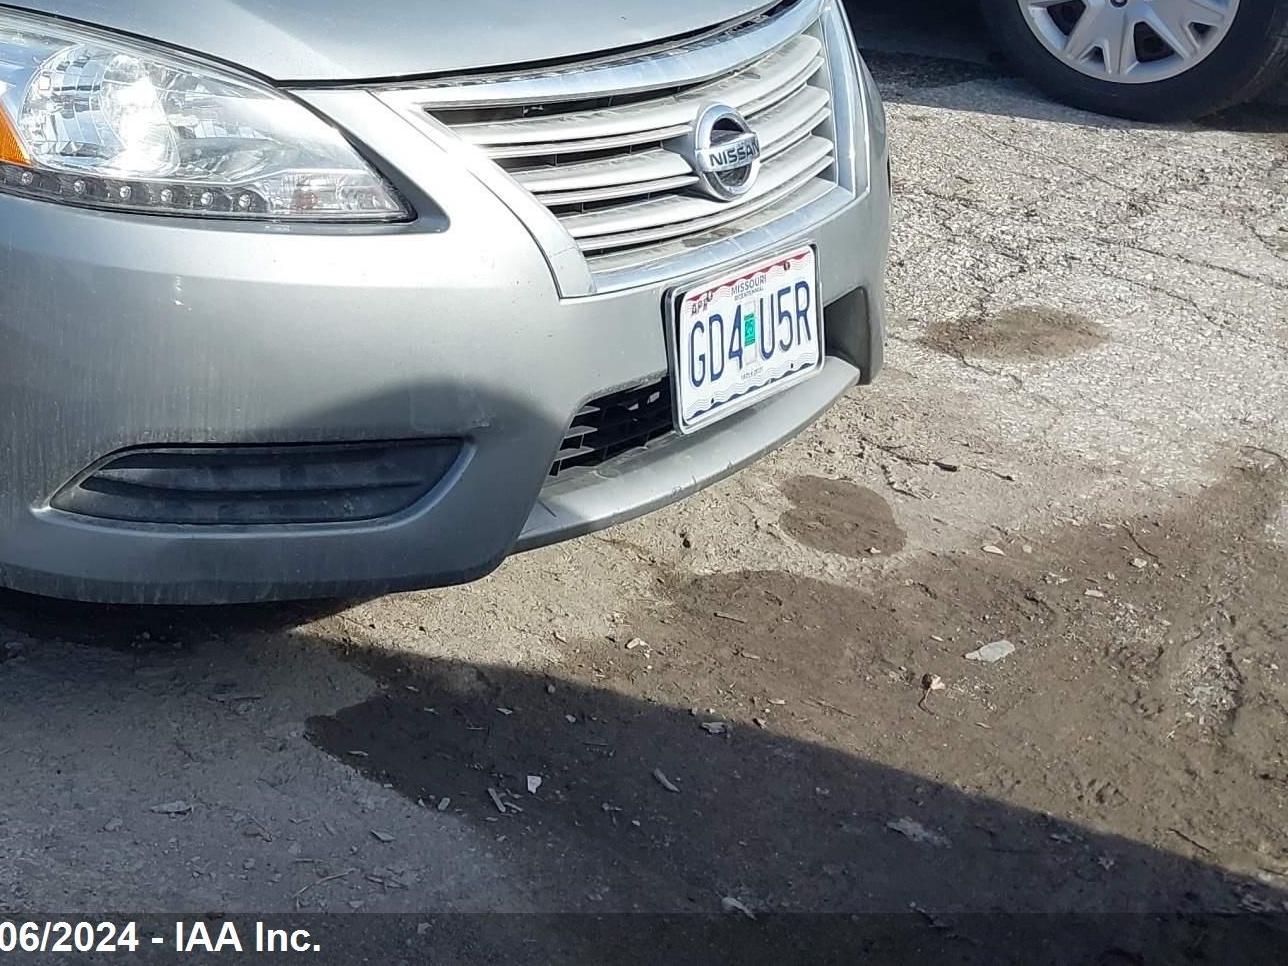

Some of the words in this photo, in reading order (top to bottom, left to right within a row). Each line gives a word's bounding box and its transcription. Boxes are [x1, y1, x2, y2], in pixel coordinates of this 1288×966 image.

[709, 138, 760, 167] NISSAN
[730, 274, 767, 297] MISSOURI
[690, 304, 743, 390] GD4
[759, 280, 811, 360] U5R
